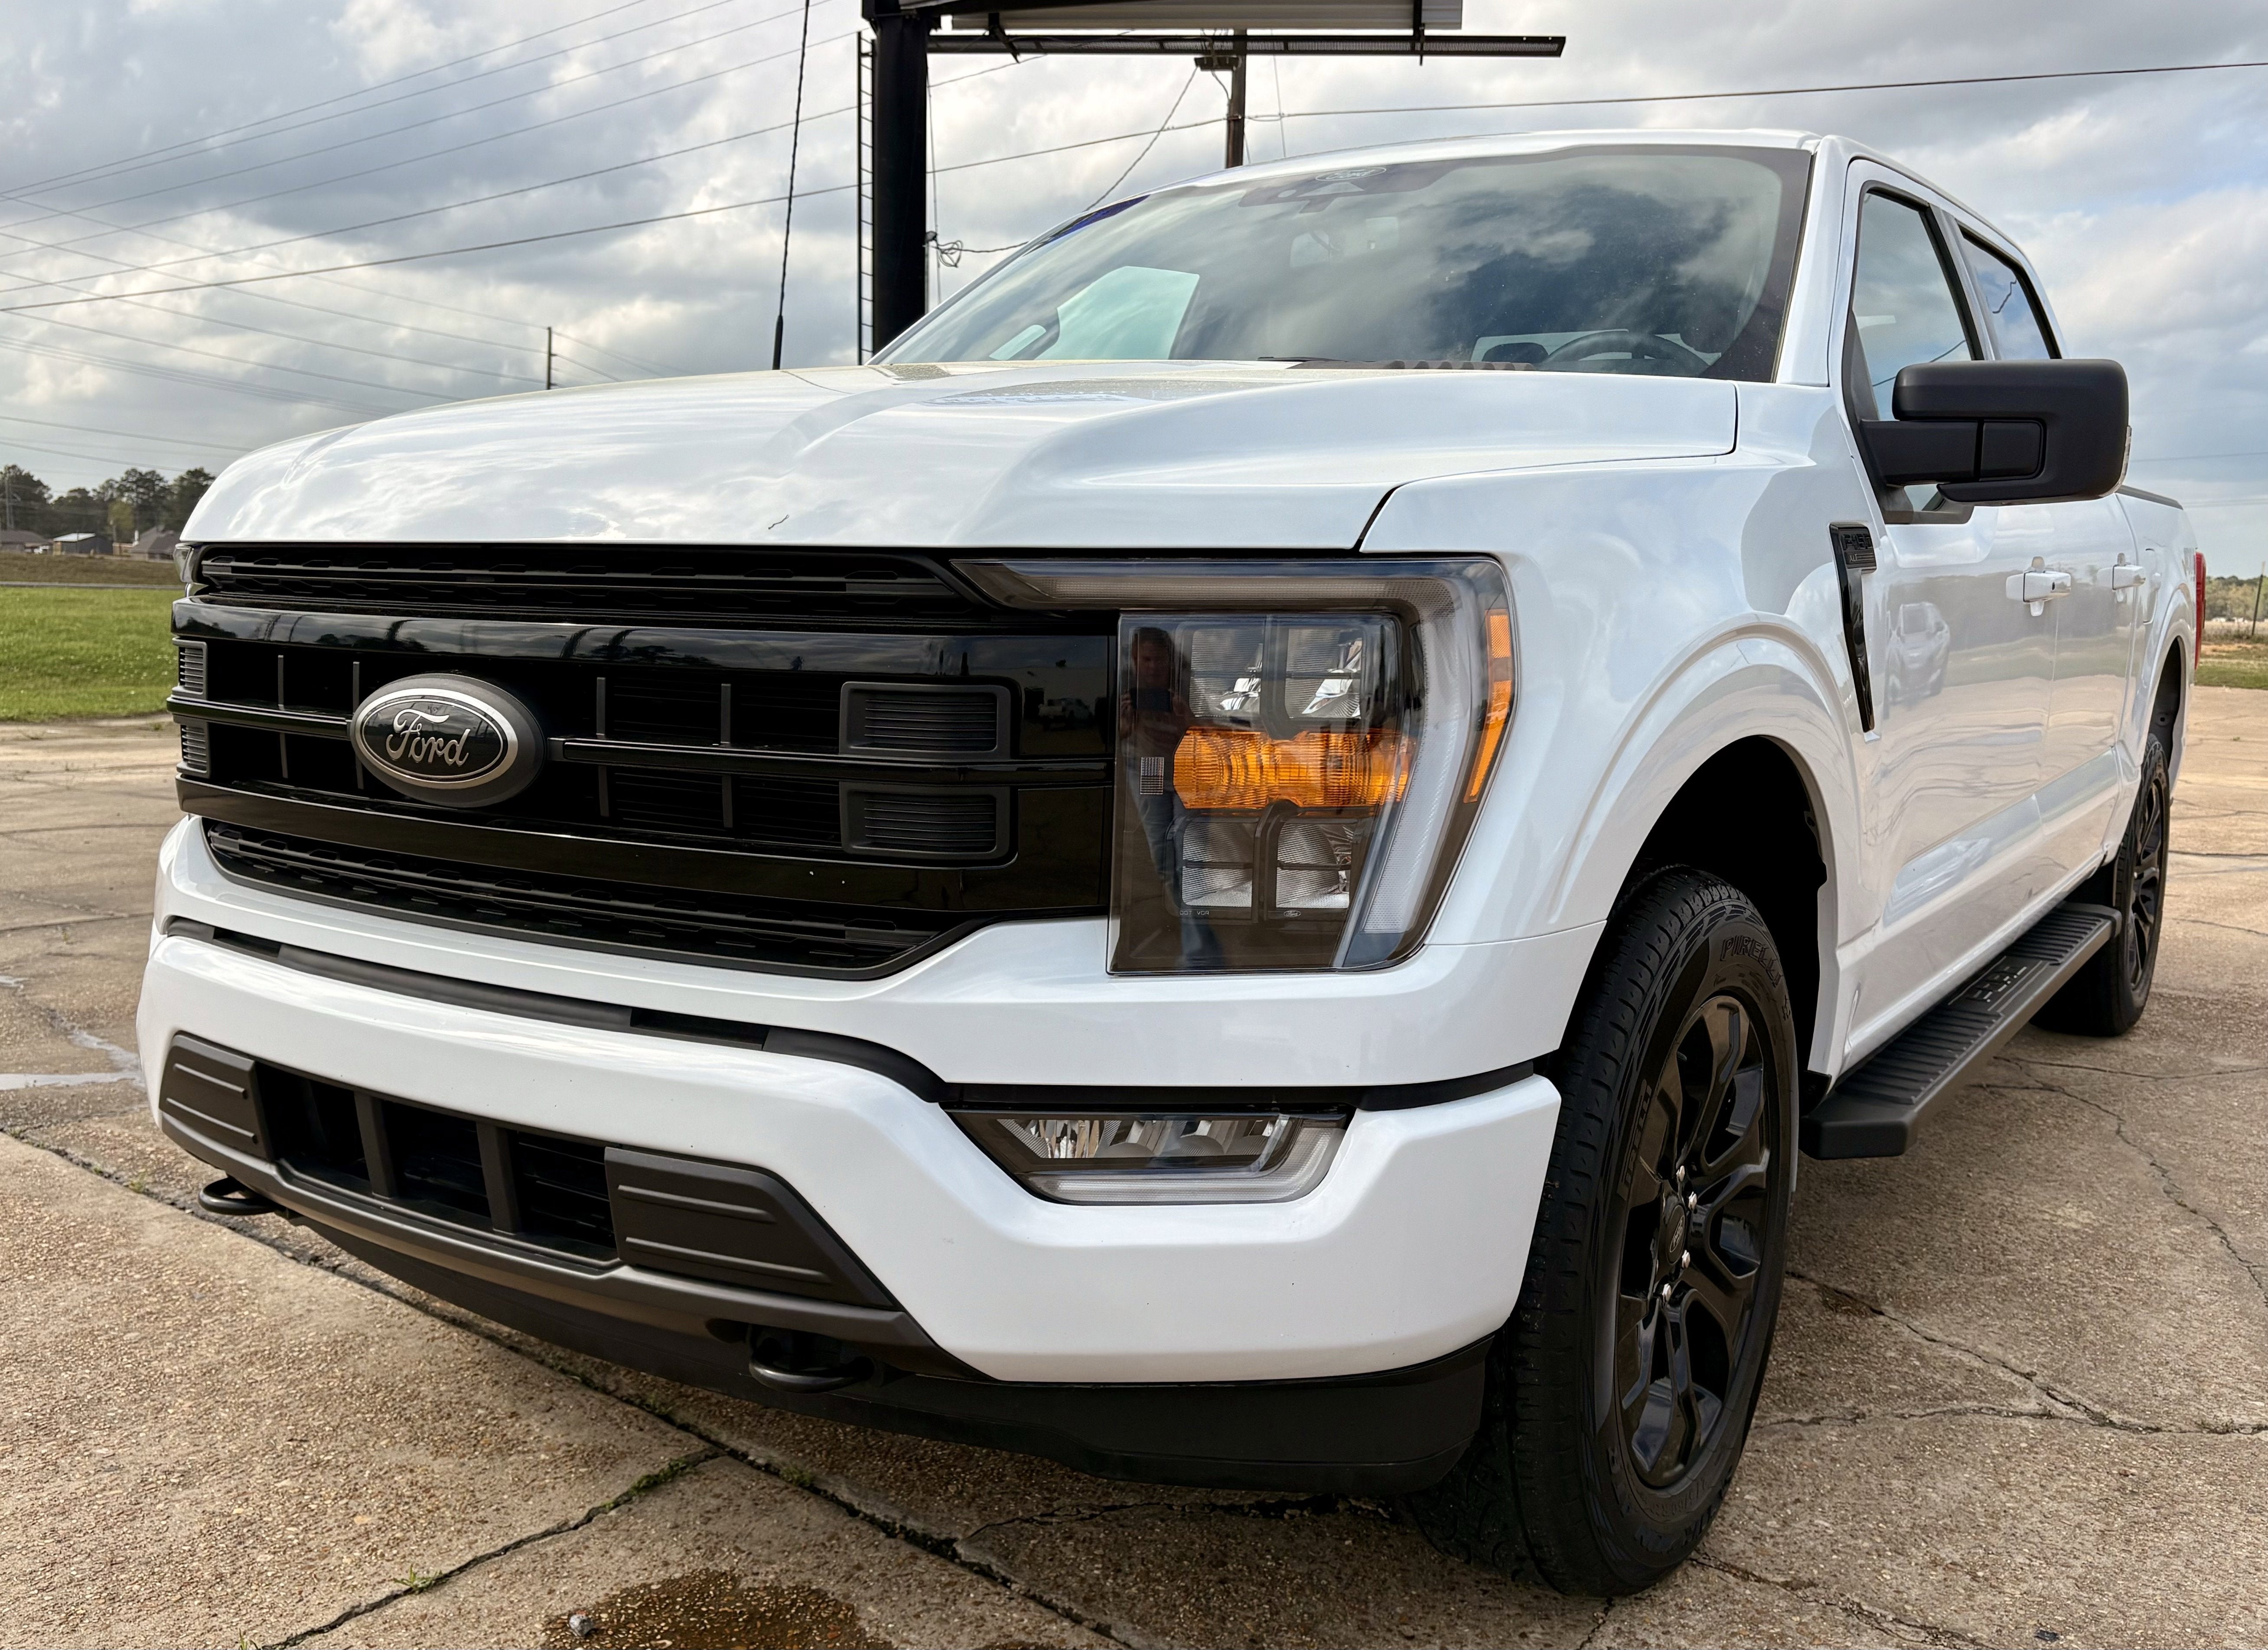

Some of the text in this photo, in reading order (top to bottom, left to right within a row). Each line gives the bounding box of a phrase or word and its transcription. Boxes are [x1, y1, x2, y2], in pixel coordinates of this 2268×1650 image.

[1324, 168, 1377, 180] Ford
[385, 708, 472, 766] Ford
[1720, 934, 1783, 988] PIRELLI
